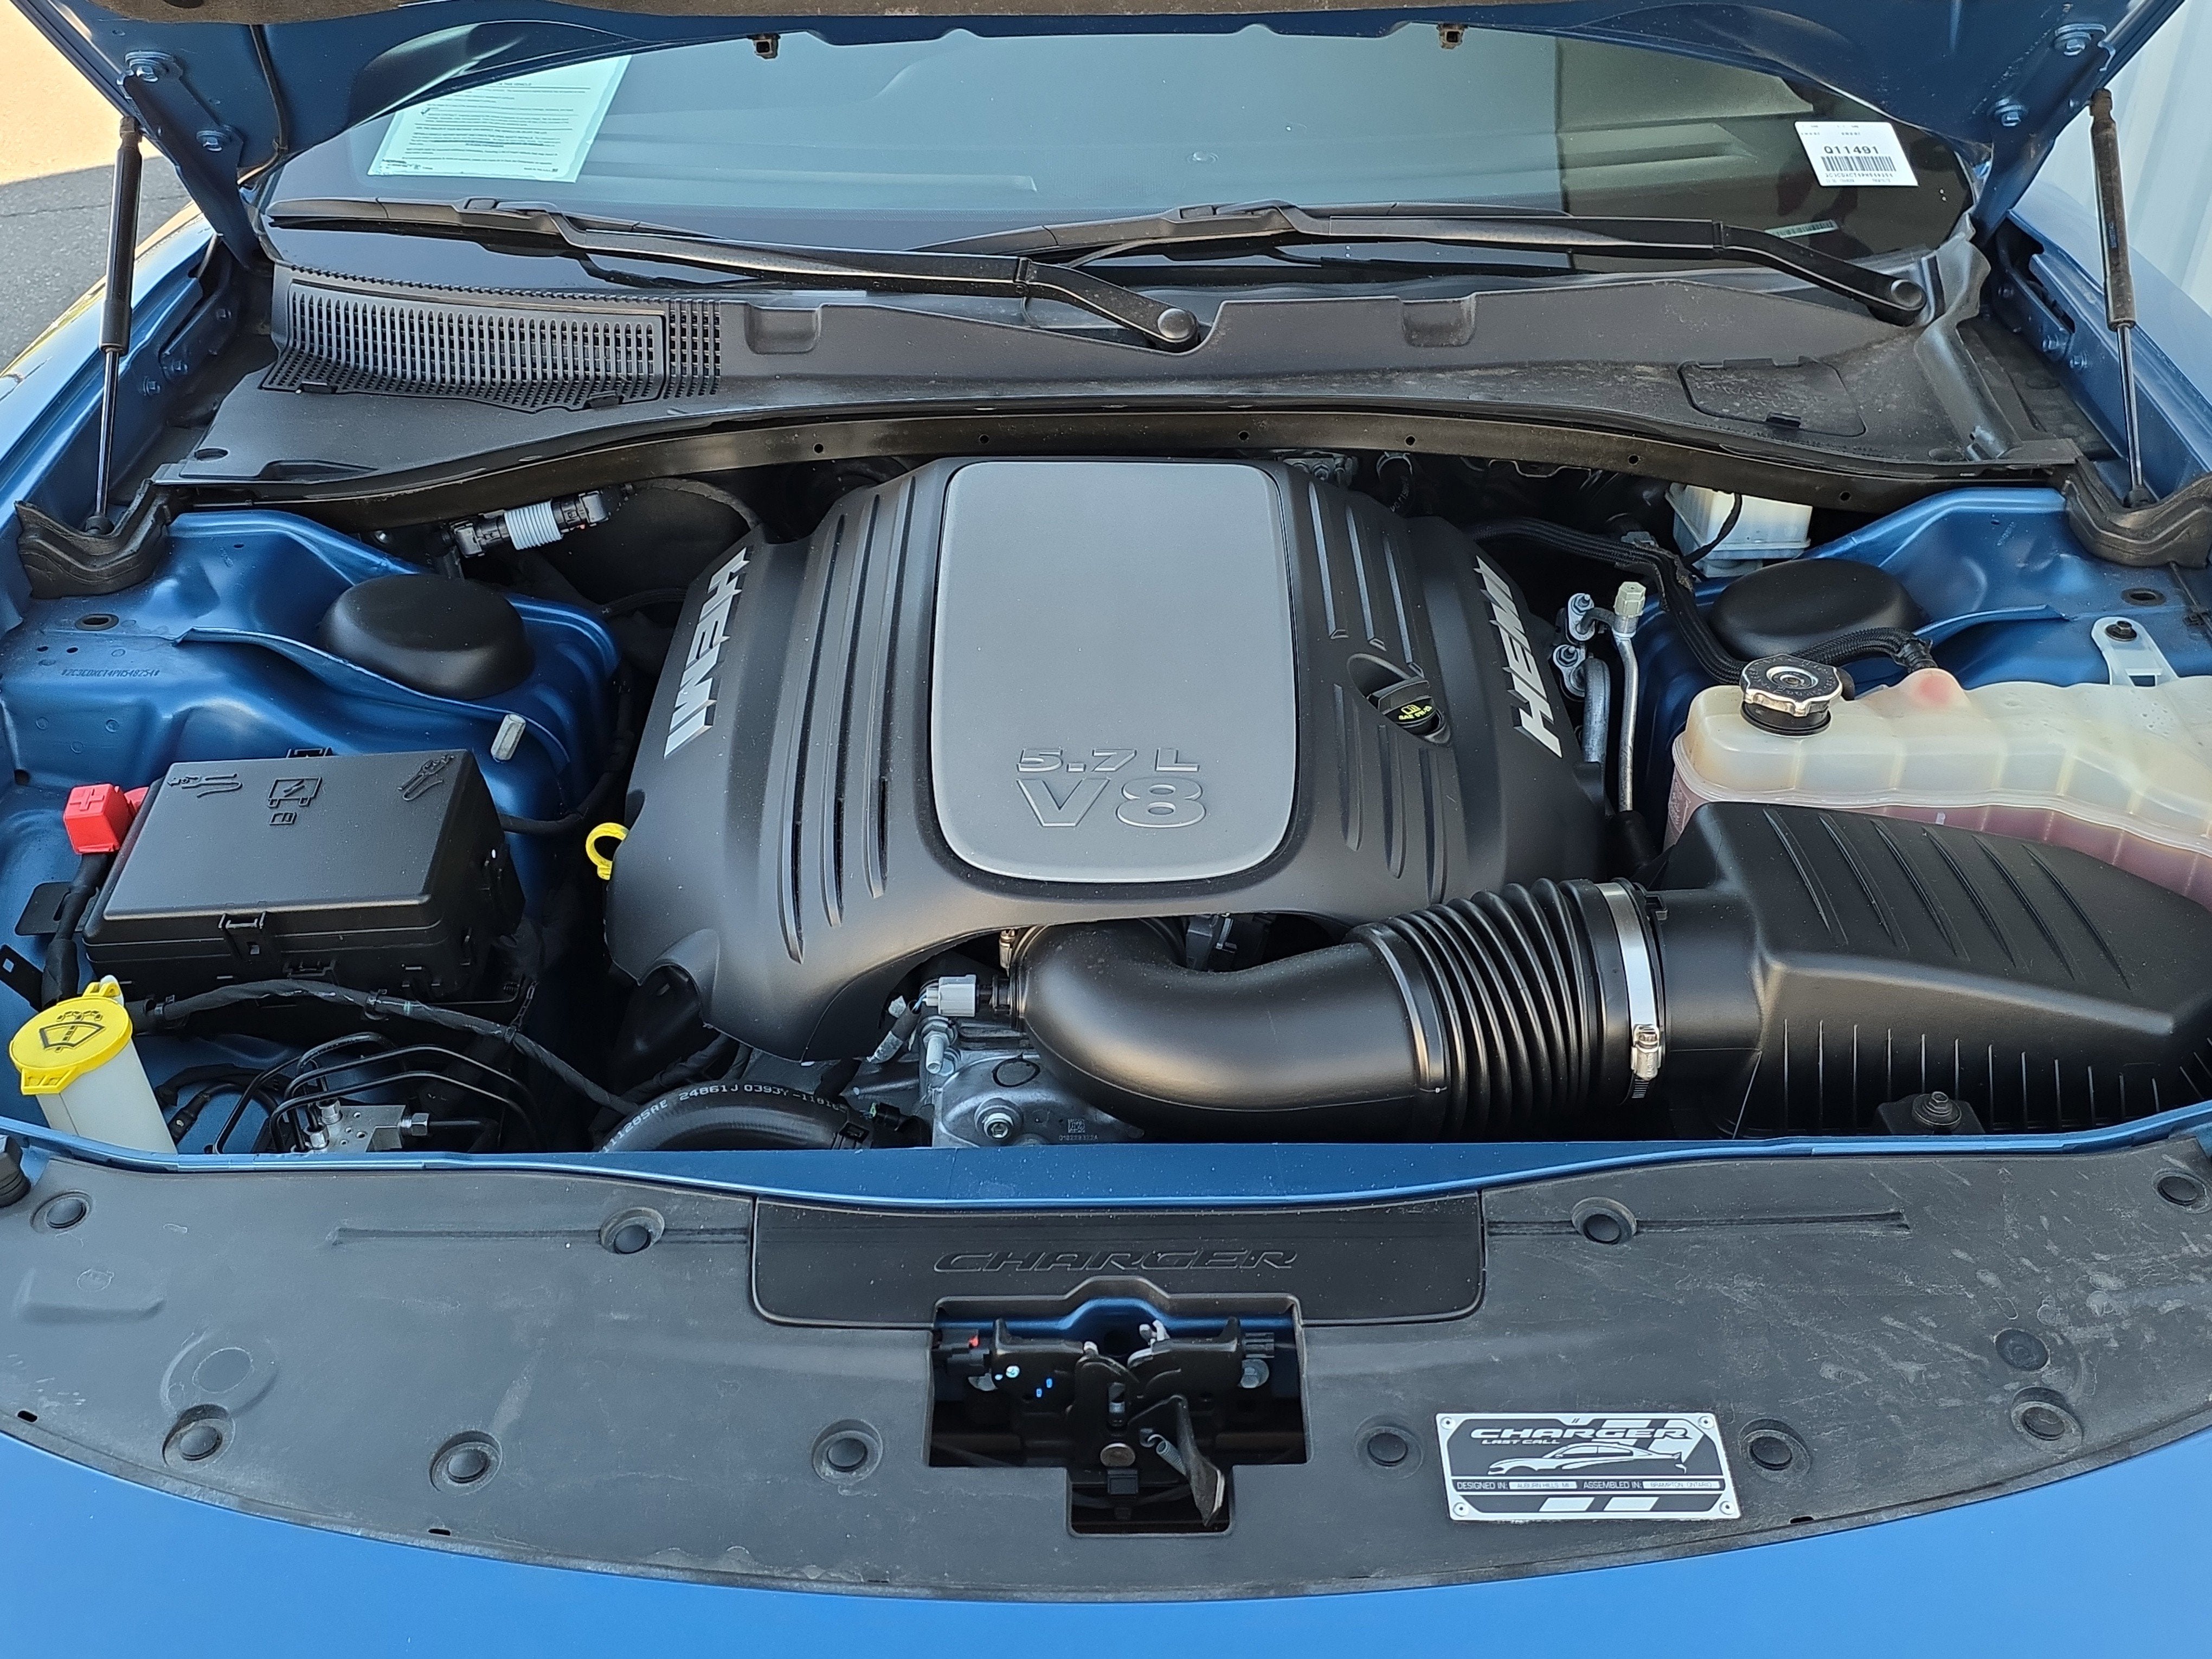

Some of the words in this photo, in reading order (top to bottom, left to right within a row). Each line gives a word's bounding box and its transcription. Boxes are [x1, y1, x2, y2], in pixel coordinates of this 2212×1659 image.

[1824, 146, 1880, 155] Q11491
[664, 546, 750, 759] HEMI
[1472, 555, 1563, 758] HEMI
[1016, 776, 1207, 828] V8
[933, 1250, 1297, 1272] CHARGER
[1470, 1427, 1693, 1440] CHARGER
[1456, 1482, 1496, 1490] DESIGNED
[1497, 1482, 1509, 1490] IN:
[1583, 1481, 1630, 1489] ASSEMBLED
[1631, 1481, 1643, 1489] IN:
